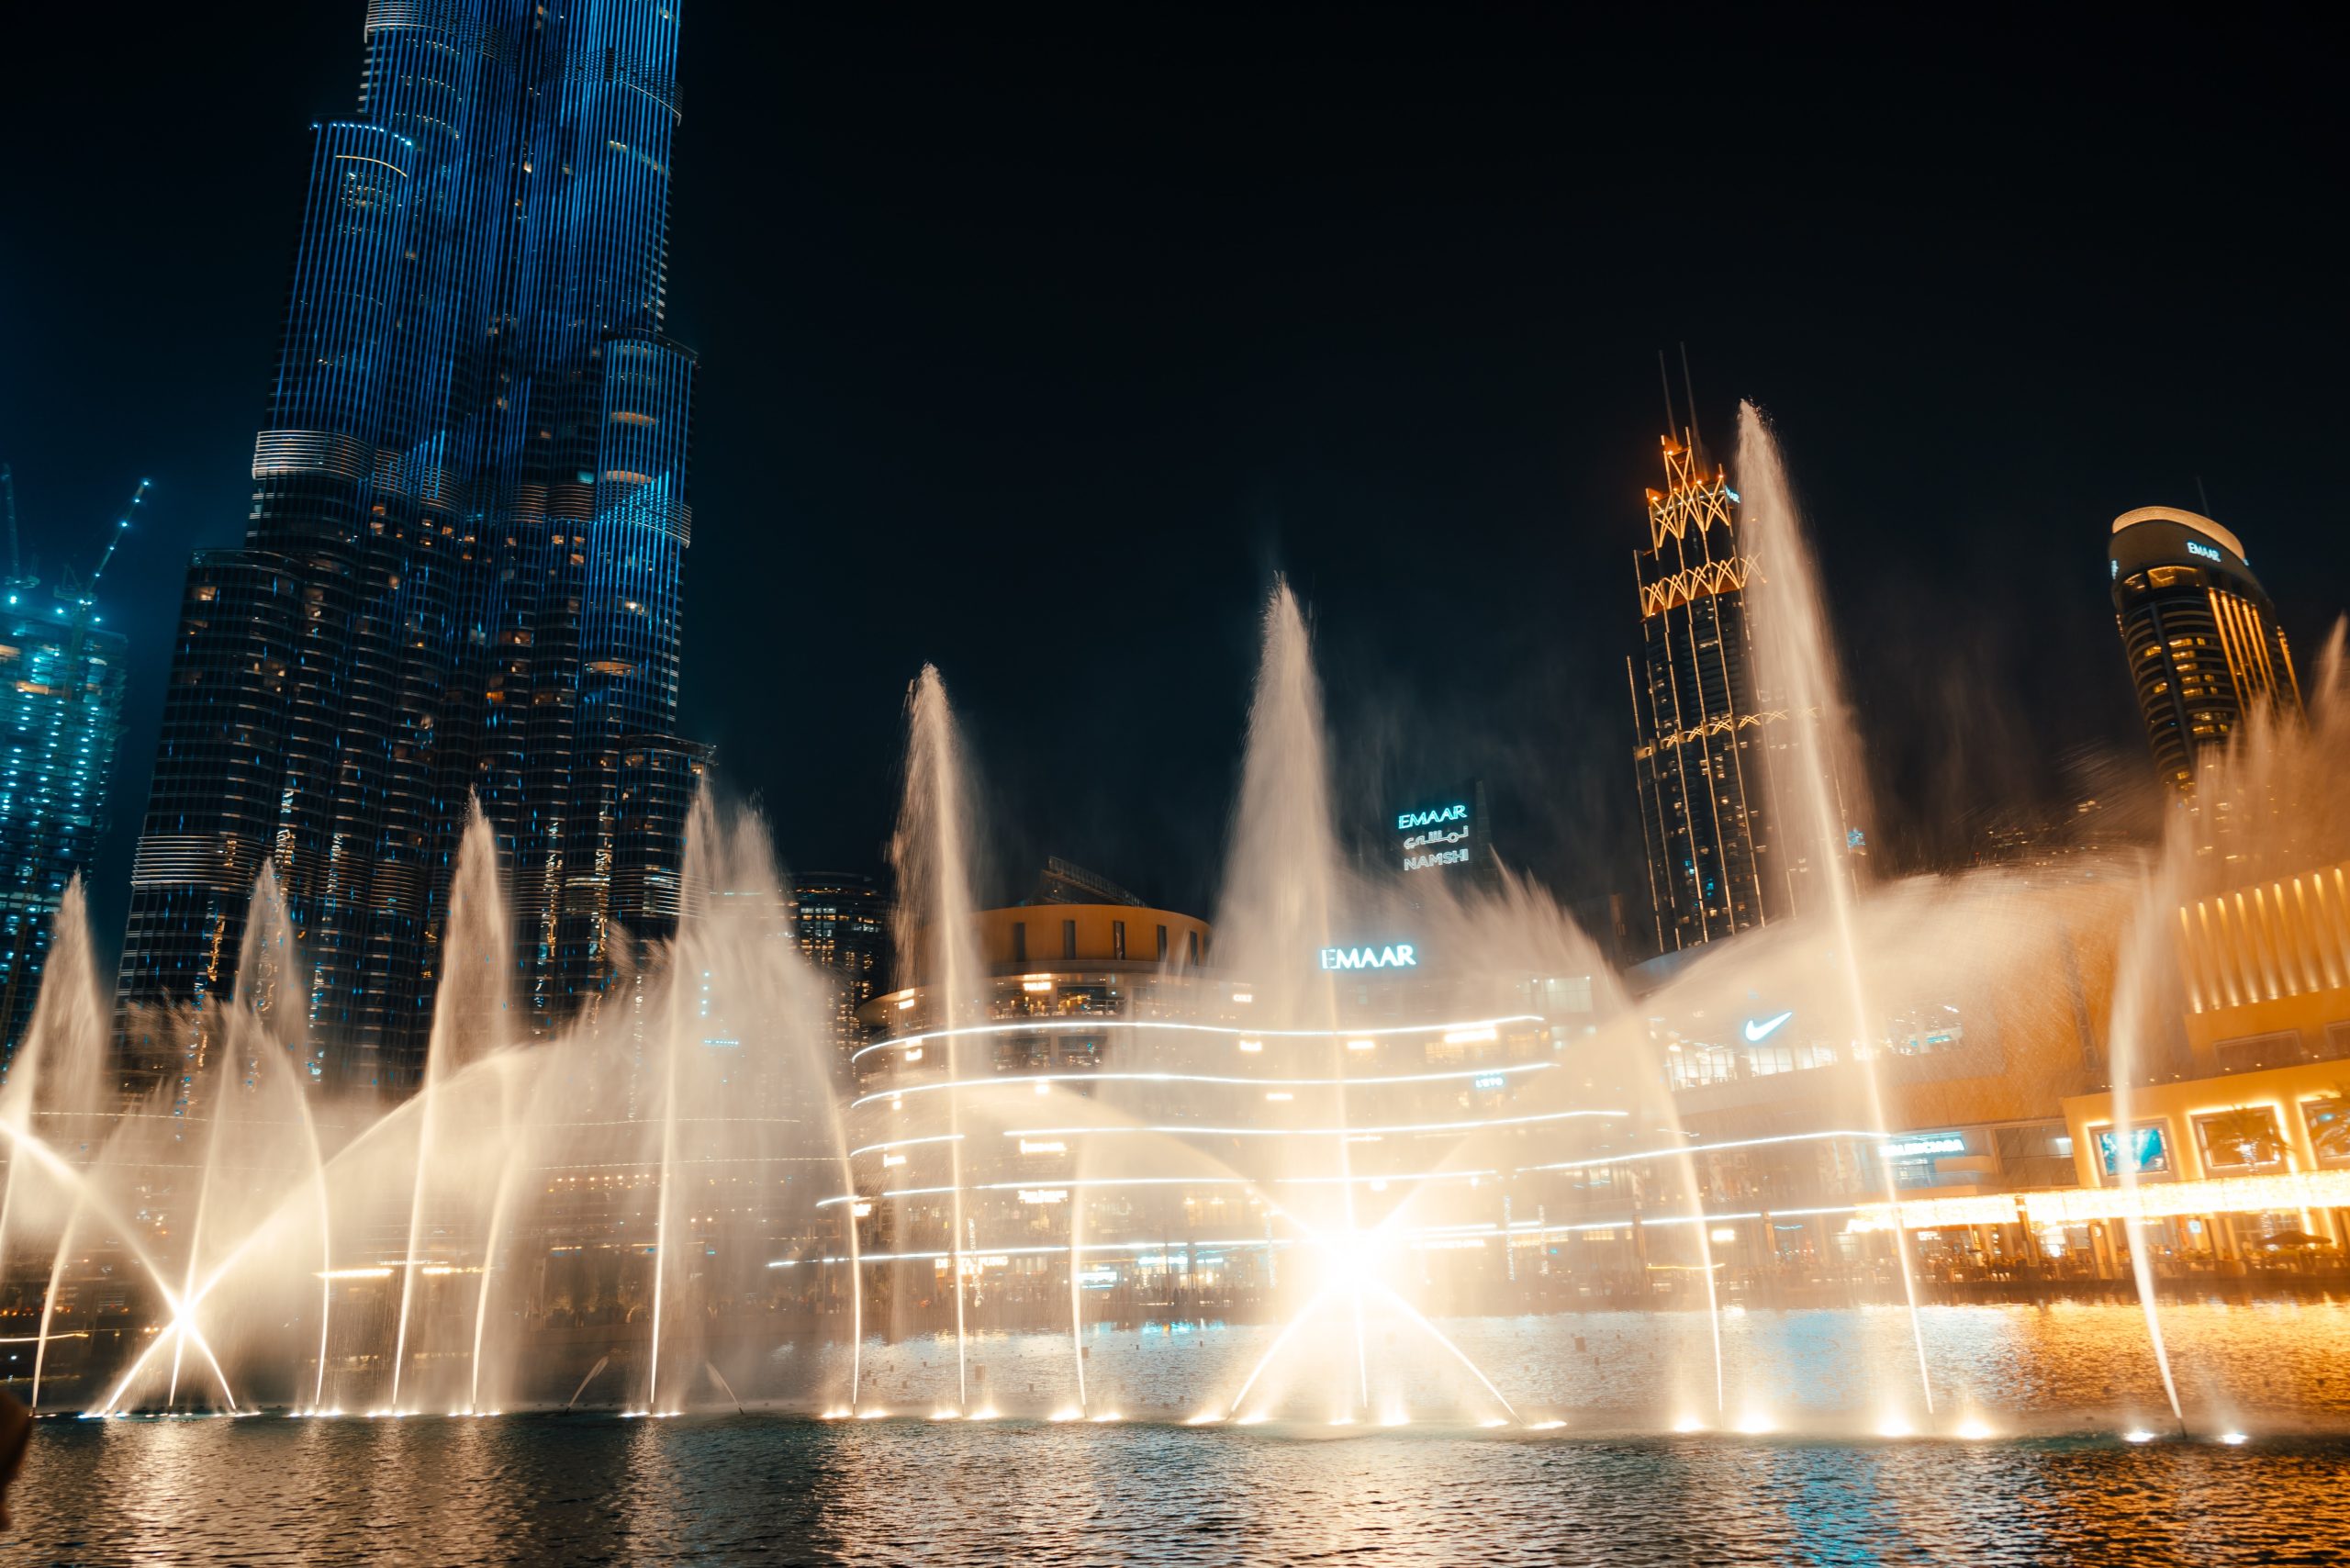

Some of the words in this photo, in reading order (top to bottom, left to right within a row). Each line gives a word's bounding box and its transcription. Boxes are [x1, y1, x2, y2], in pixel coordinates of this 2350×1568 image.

[2187, 542, 2221, 563] EMAAR
[1398, 805, 1468, 829] EMAAR
[1404, 848, 1469, 871] NAMSHI
[1321, 945, 1416, 969] EMAAR
